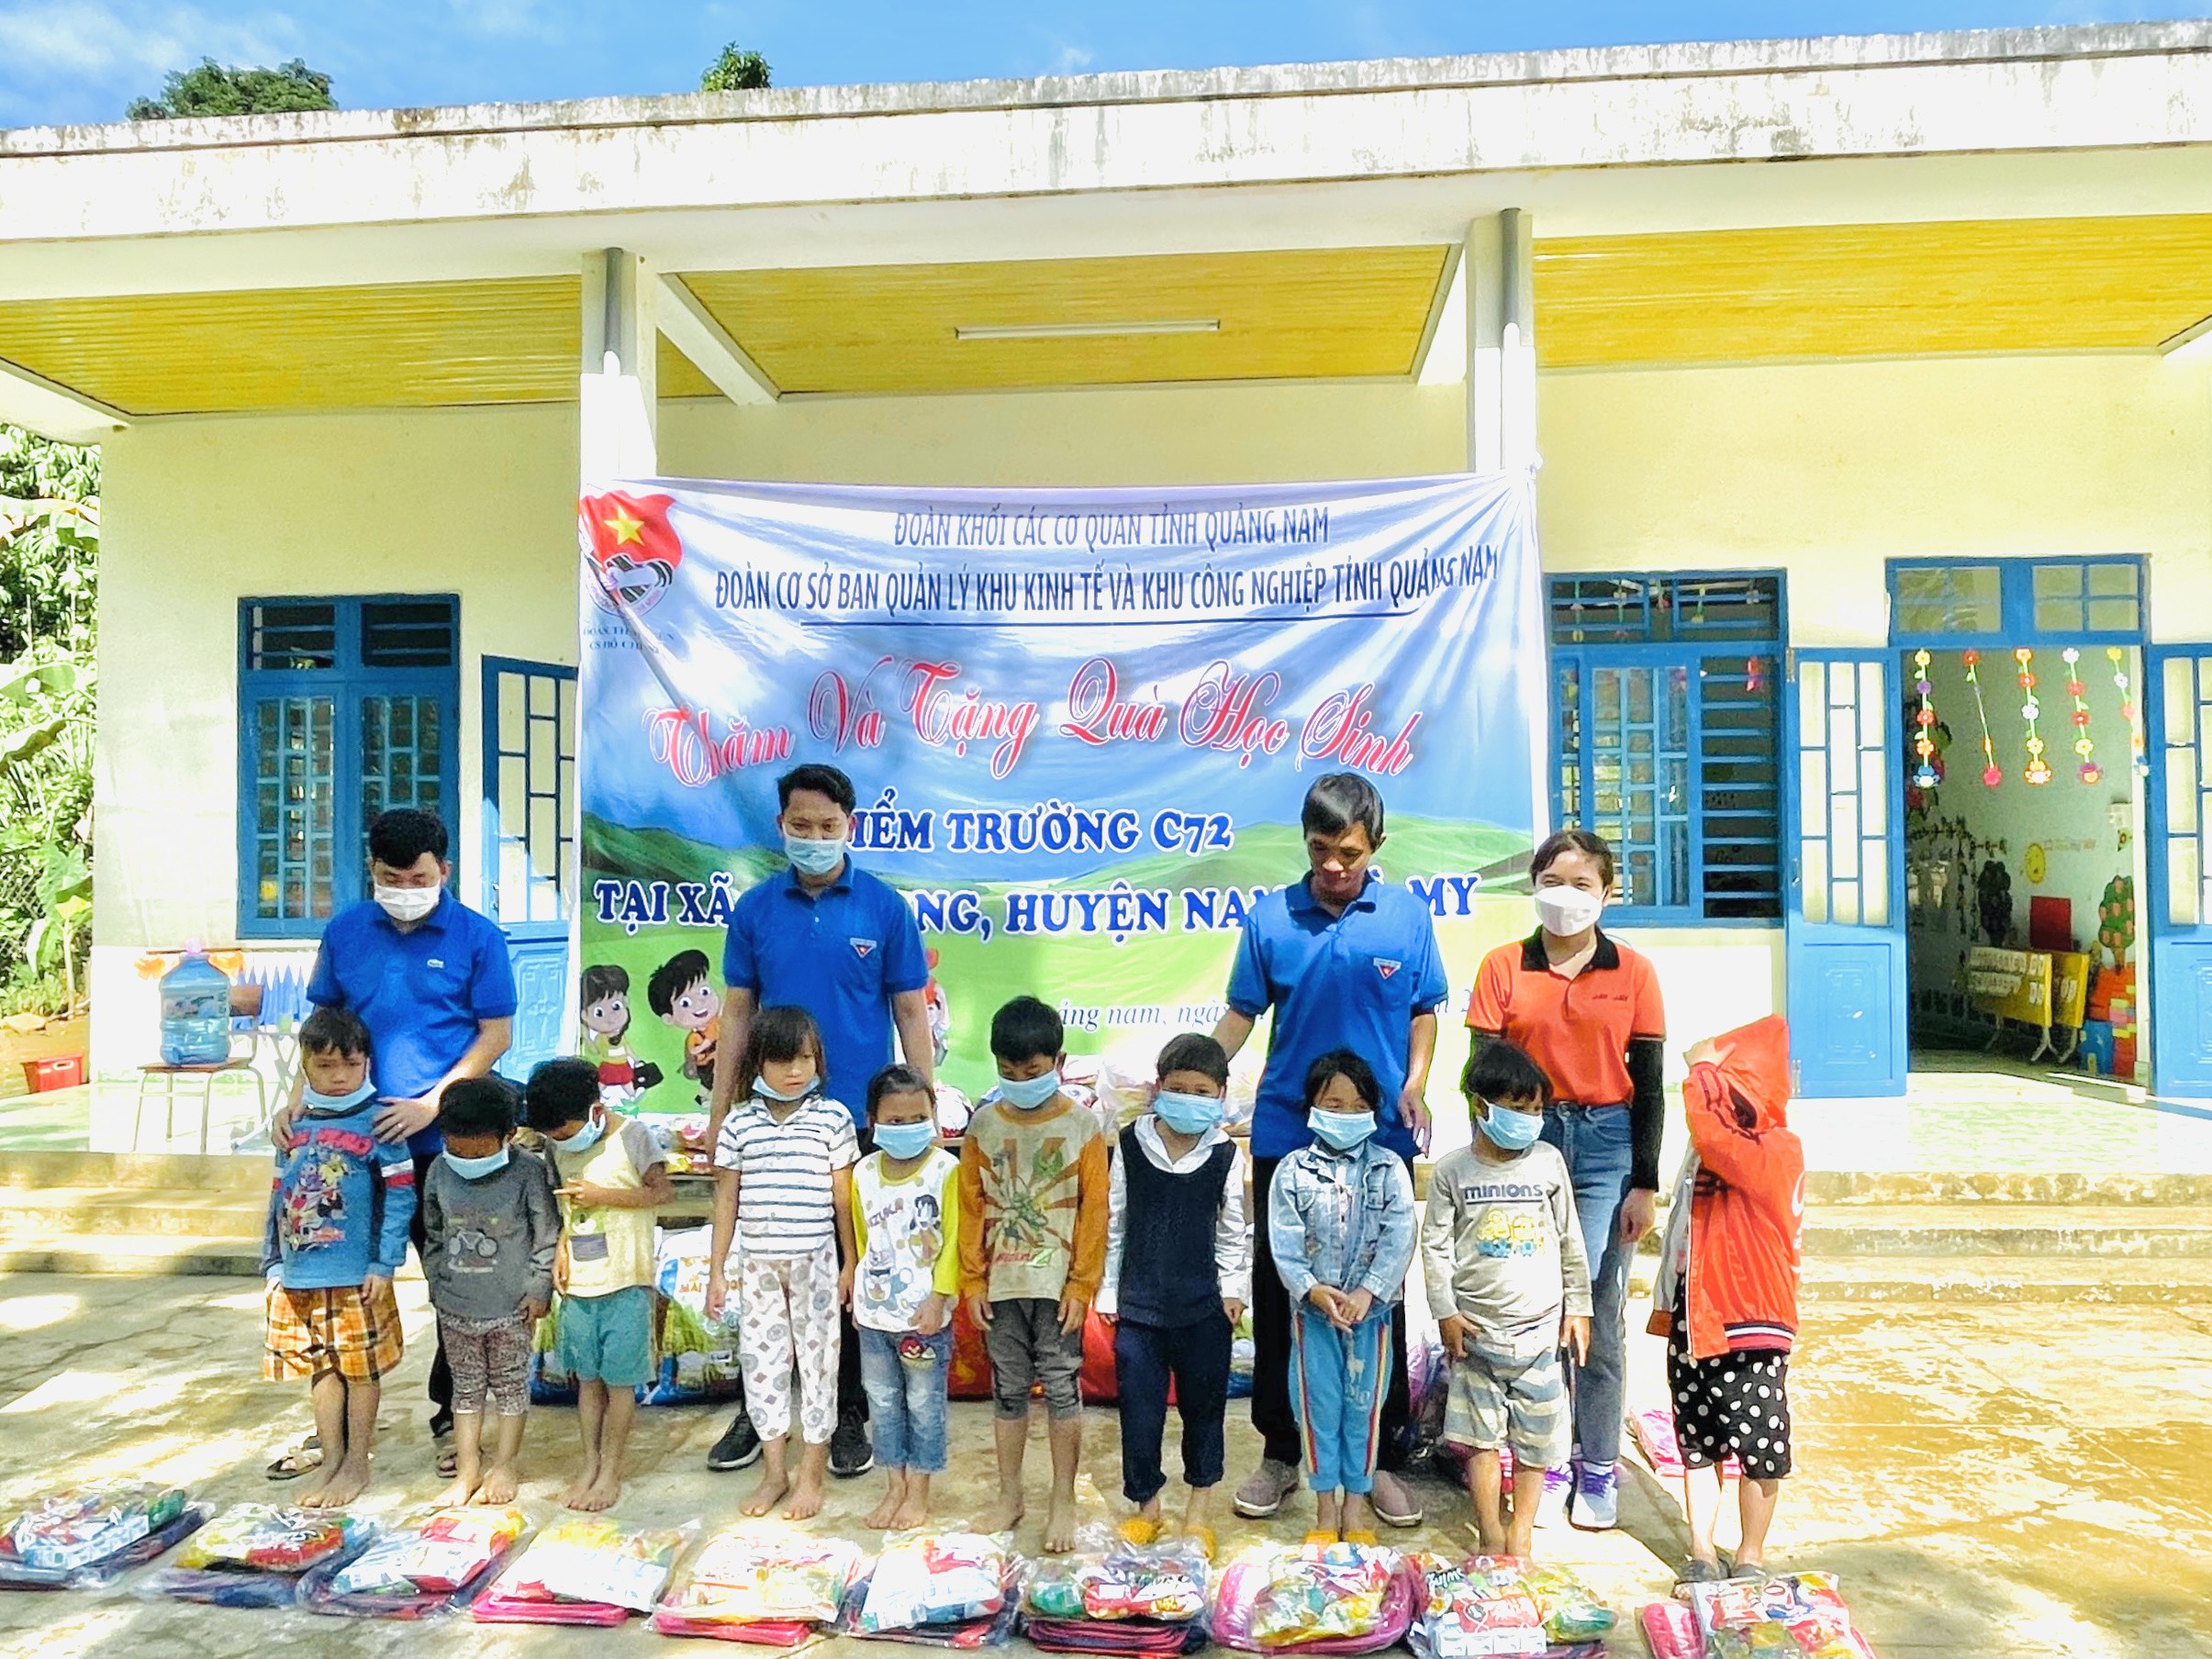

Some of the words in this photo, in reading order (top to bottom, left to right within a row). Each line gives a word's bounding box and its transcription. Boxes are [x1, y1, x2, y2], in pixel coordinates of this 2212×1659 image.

[895, 506, 951, 545] ĐOÀN
[956, 503, 1008, 545] KHỐI
[1013, 506, 1048, 545] CÁC
[1055, 513, 1080, 545] CƠ
[1085, 515, 1141, 552] QUAN
[1149, 504, 1197, 543] TỈNH
[1205, 503, 1275, 552] QUẢNG
[1284, 507, 1328, 543] NAM
[715, 562, 772, 608] ĐOÀN
[776, 571, 802, 609] CƠ
[806, 561, 833, 609] SỞ
[837, 573, 879, 609] BAN
[886, 561, 941, 618] QUẢN
[948, 562, 970, 610] LÝ
[976, 573, 1016, 610] KHU
[1024, 573, 1073, 610] KINH
[1080, 558, 1105, 611] TẾ
[1108, 562, 1135, 610] VÀ
[1142, 572, 1183, 610] KHU
[1191, 562, 1244, 608] CÔNG
[1251, 562, 1326, 613] NGHIỆP
[1333, 555, 1382, 603] TỈNH
[1390, 548, 1458, 607] QUẢNG
[1458, 543, 1500, 587] NAM
[644, 708, 795, 787] Thăm
[808, 654, 894, 756] Và
[898, 659, 1040, 780] Tặng
[1179, 658, 1290, 770] Học
[1296, 683, 1424, 775] Sinh
[850, 787, 934, 851] IỂM
[944, 798, 1141, 852] TRƯỜNG
[1152, 808, 1234, 856] C72
[594, 878, 670, 936] TẠI
[676, 871, 734, 927] XÃ
[912, 888, 993, 943] NG,
[1003, 877, 1173, 947] HUYỆN
[1057, 1000, 1100, 1031] ảng
[1176, 998, 1230, 1029] ngà
